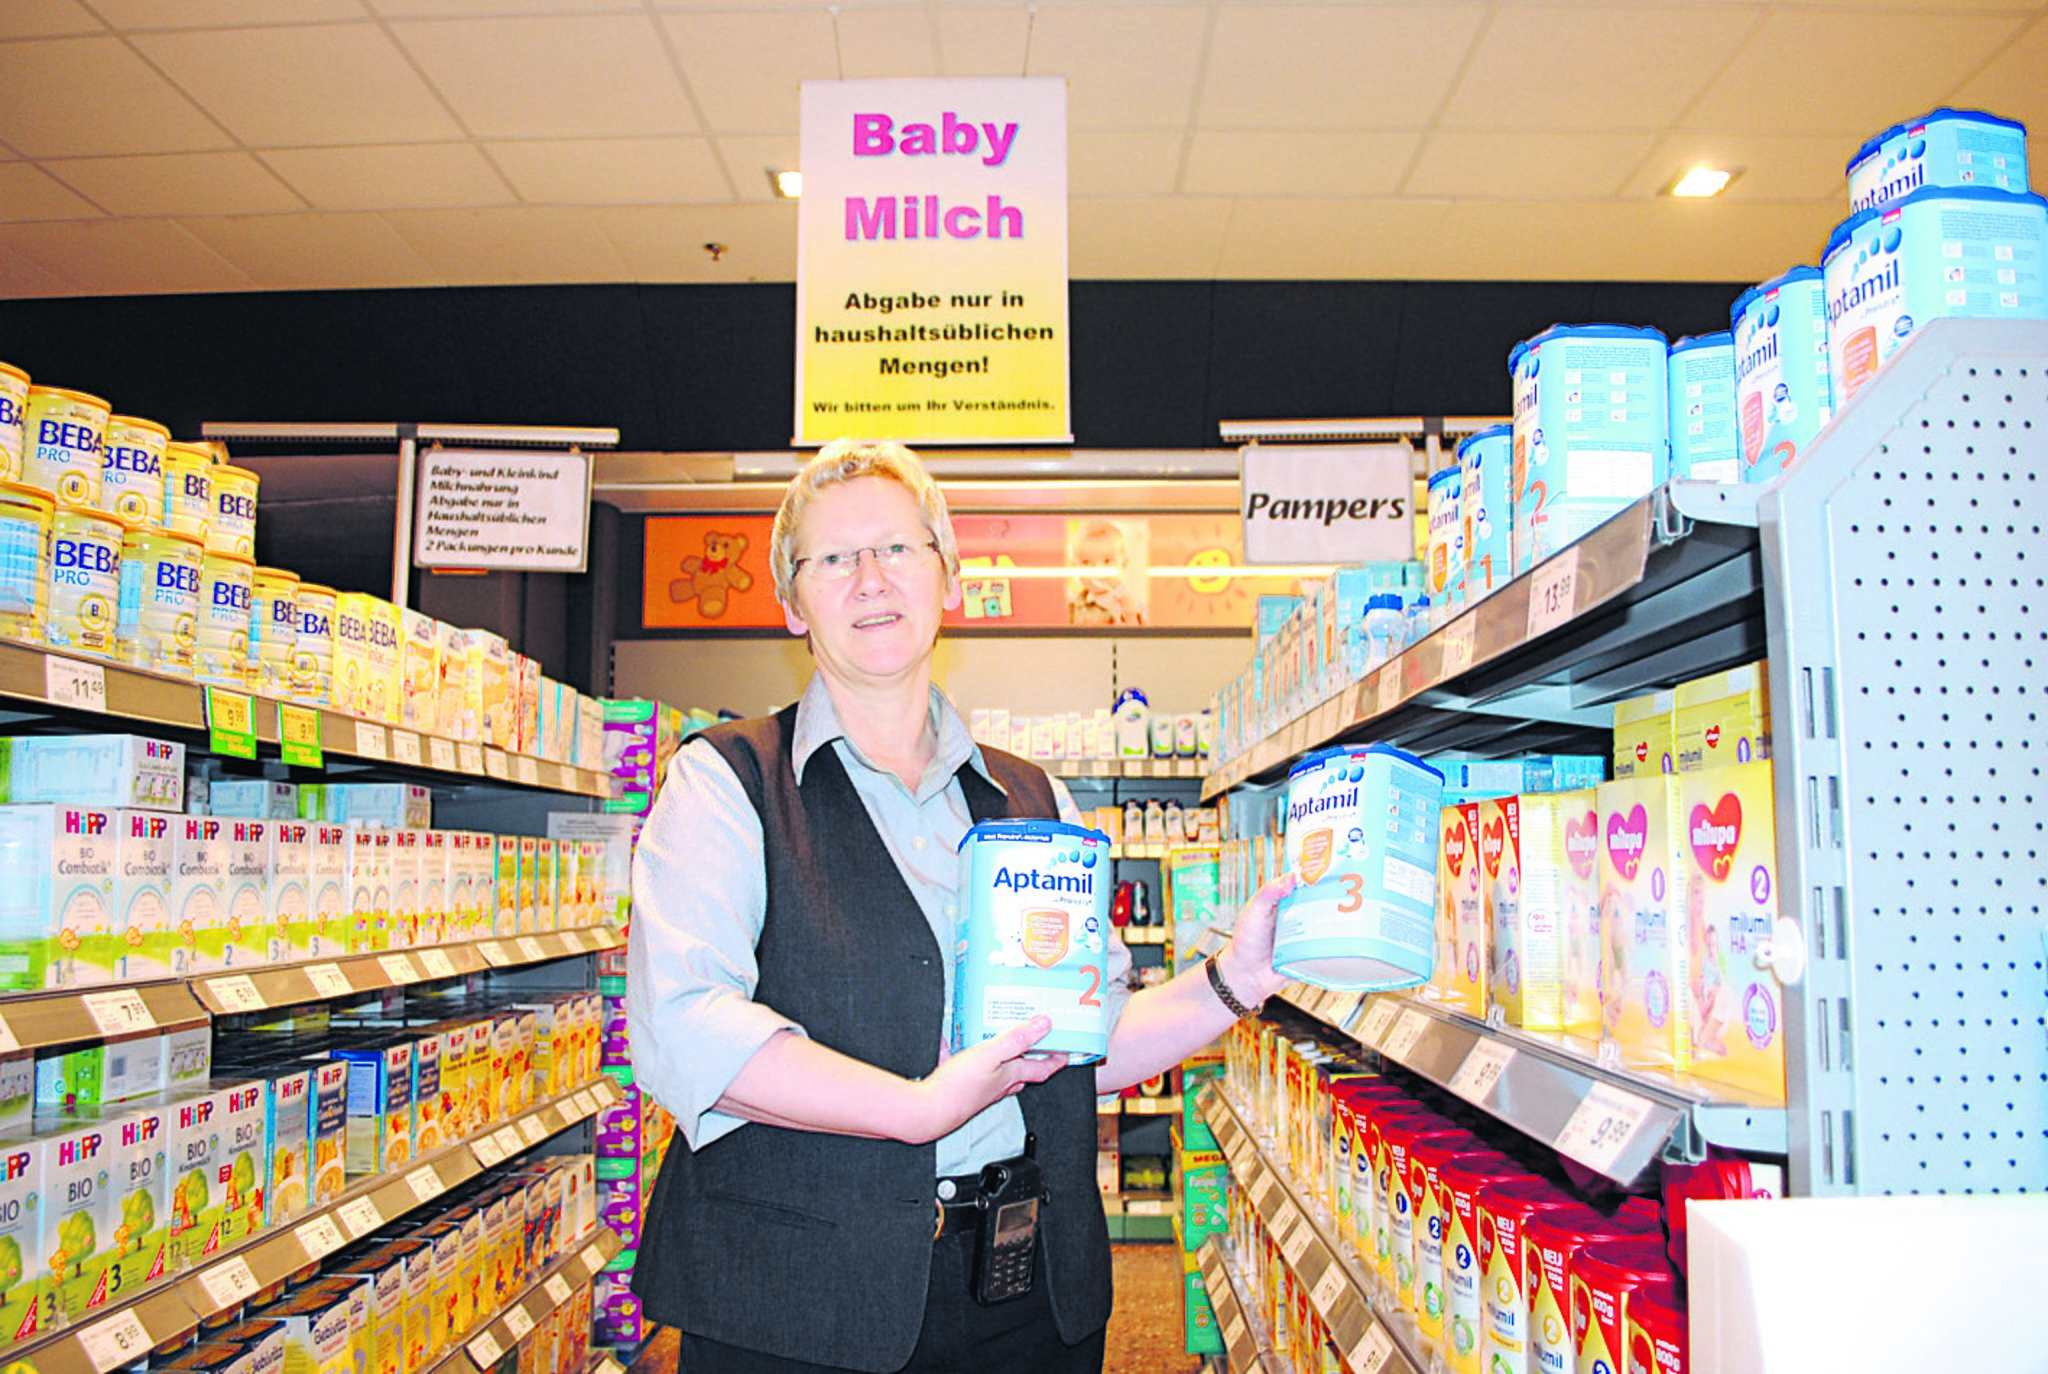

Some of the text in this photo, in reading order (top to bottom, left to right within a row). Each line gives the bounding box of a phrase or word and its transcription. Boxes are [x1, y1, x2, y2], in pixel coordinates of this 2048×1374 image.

[853, 112, 1018, 166] Baby
[845, 195, 1024, 240] Milch
[845, 291, 1025, 313] Abgabe nur in
[815, 323, 1054, 343] haushaltsüblichen
[880, 357, 989, 377] Mengen!
[813, 399, 1056, 413] Wir bitten um Ihr Verständnis.
[39, 419, 104, 456] BEBA
[37, 446, 71, 463] PRO
[470, 467, 496, 477] und
[497, 467, 559, 479] Kleinkind
[430, 481, 519, 496] Milchnahrung
[430, 495, 519, 509] Abgabe nur in
[1247, 493, 1406, 526] Pampers
[426, 525, 479, 538] Mengen
[436, 540, 508, 554] Packungen
[537, 543, 578, 555] Kunde
[54, 569, 90, 585] PRO
[1481, 554, 1492, 589] 1
[155, 588, 184, 605] PRO
[147, 741, 173, 760] HiPP
[1288, 787, 1358, 822] Aptamil
[66, 810, 107, 835] HiPP
[131, 816, 168, 838] HiPP
[185, 819, 220, 840] HiPP
[234, 822, 264, 842] HiPP
[279, 824, 306, 844] HiPP
[319, 827, 343, 845] HiPP
[1610, 825, 1643, 856] milupa
[1692, 818, 1736, 851] milupa
[993, 866, 1092, 895] Aptamil
[1754, 868, 1766, 901] 2
[1337, 873, 1364, 913] 3
[1730, 911, 1773, 933] milumil
[1731, 934, 1747, 954] HA
[119, 955, 128, 977] 1
[224, 945, 234, 966] 2
[1078, 964, 1102, 1008] 2
[282, 1079, 304, 1099] HiPP
[229, 1088, 259, 1114] HiPP
[180, 1101, 214, 1129] HiPP
[122, 1116, 160, 1146] HiPP
[236, 1123, 253, 1144] BIO
[59, 1133, 102, 1167] HiPP
[187, 1139, 207, 1161] BIO
[0, 1152, 31, 1182] iPP
[130, 1157, 151, 1180] BIO
[68, 1177, 93, 1202] BIO
[220, 1218, 232, 1237] 12
[1430, 1218, 1440, 1239] 2
[1497, 1215, 1515, 1233] NEU
[1457, 1247, 1469, 1267] 2
[1543, 1248, 1563, 1268] NEU
[110, 1264, 122, 1293] 3
[1499, 1280, 1511, 1302] 2
[44, 1292, 56, 1323] 3
[1546, 1318, 1557, 1342] 2
[1656, 1347, 1680, 1372] 800g
